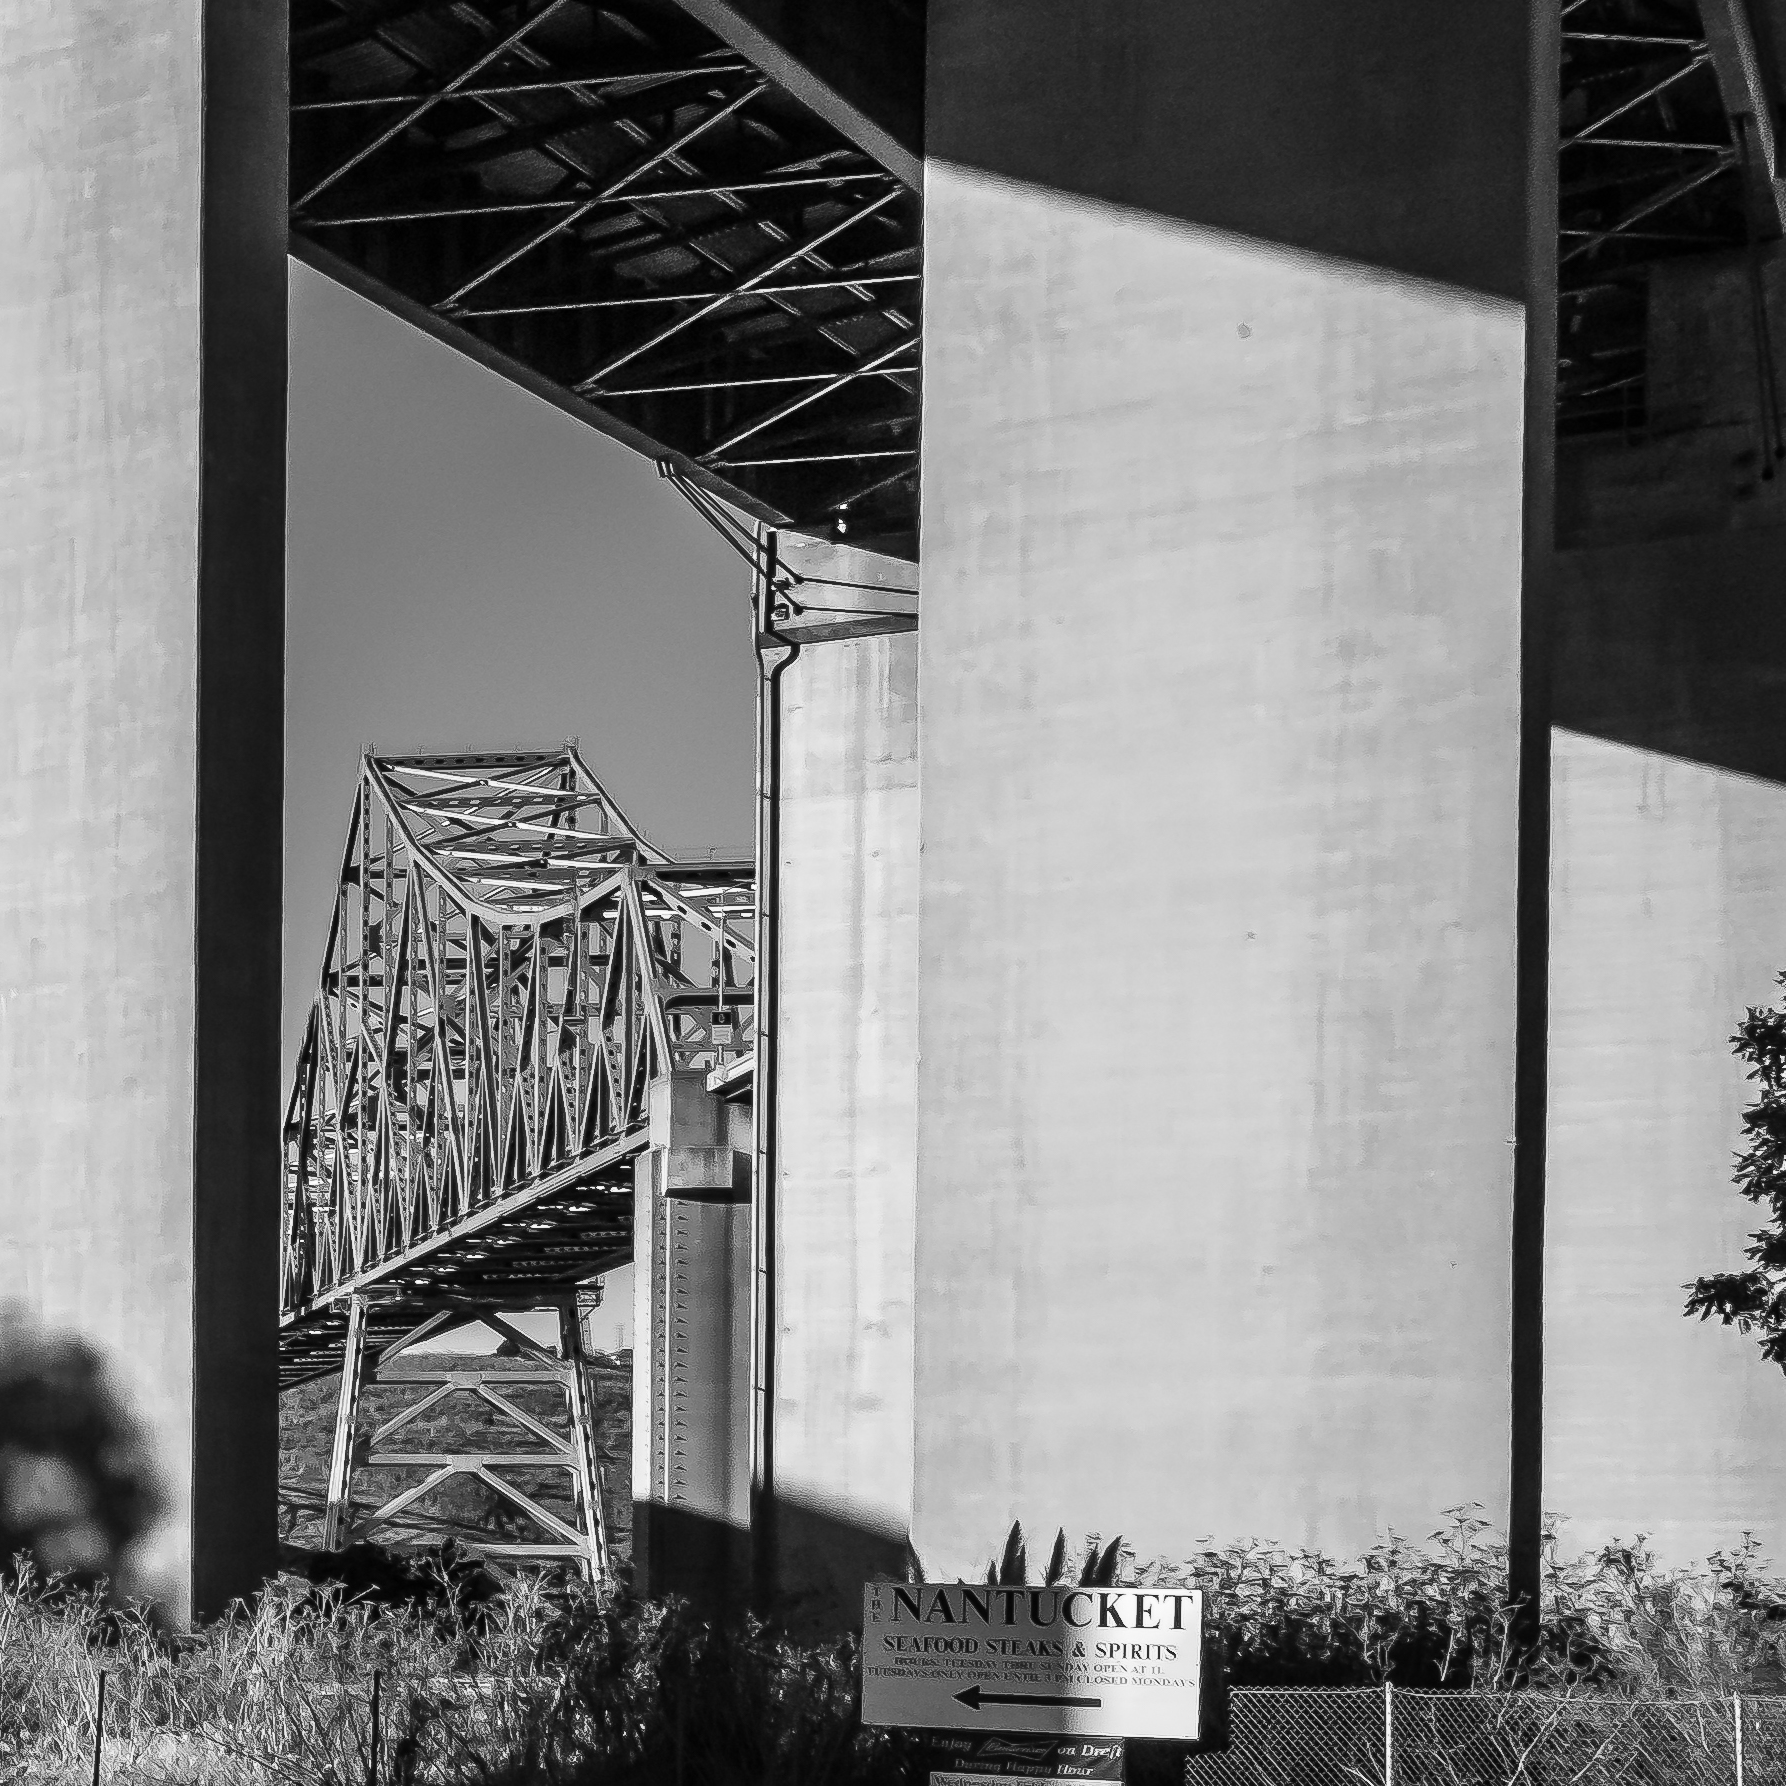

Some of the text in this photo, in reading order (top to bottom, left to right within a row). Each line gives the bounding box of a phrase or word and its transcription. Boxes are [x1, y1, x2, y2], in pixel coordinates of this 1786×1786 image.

[891, 1587, 1193, 1630] NANTUCKET
[883, 1635, 1177, 1660] SEAFOOD STEAKS & SPIRITS
[942, 1658, 997, 1669] TUESDAY
[1040, 1662, 1089, 1672] SUNDAY
[1093, 1664, 1127, 1673] OPEN
[1131, 1665, 1147, 1674] AT
[867, 1667, 929, 1678] TUESDAYS
[931, 1669, 963, 1679] ONLY
[967, 1670, 1000, 1680] OPEN
[1004, 1672, 1042, 1682] UNTIL
[1055, 1673, 1074, 1683] PM
[1076, 1675, 1128, 1685] CLOSED
[1131, 1676, 1196, 1688] MONDAYS
[931, 1736, 973, 1752] Enjoy
[1057, 1746, 1076, 1756] on
[954, 1758, 1094, 1776] During Happy Hour
